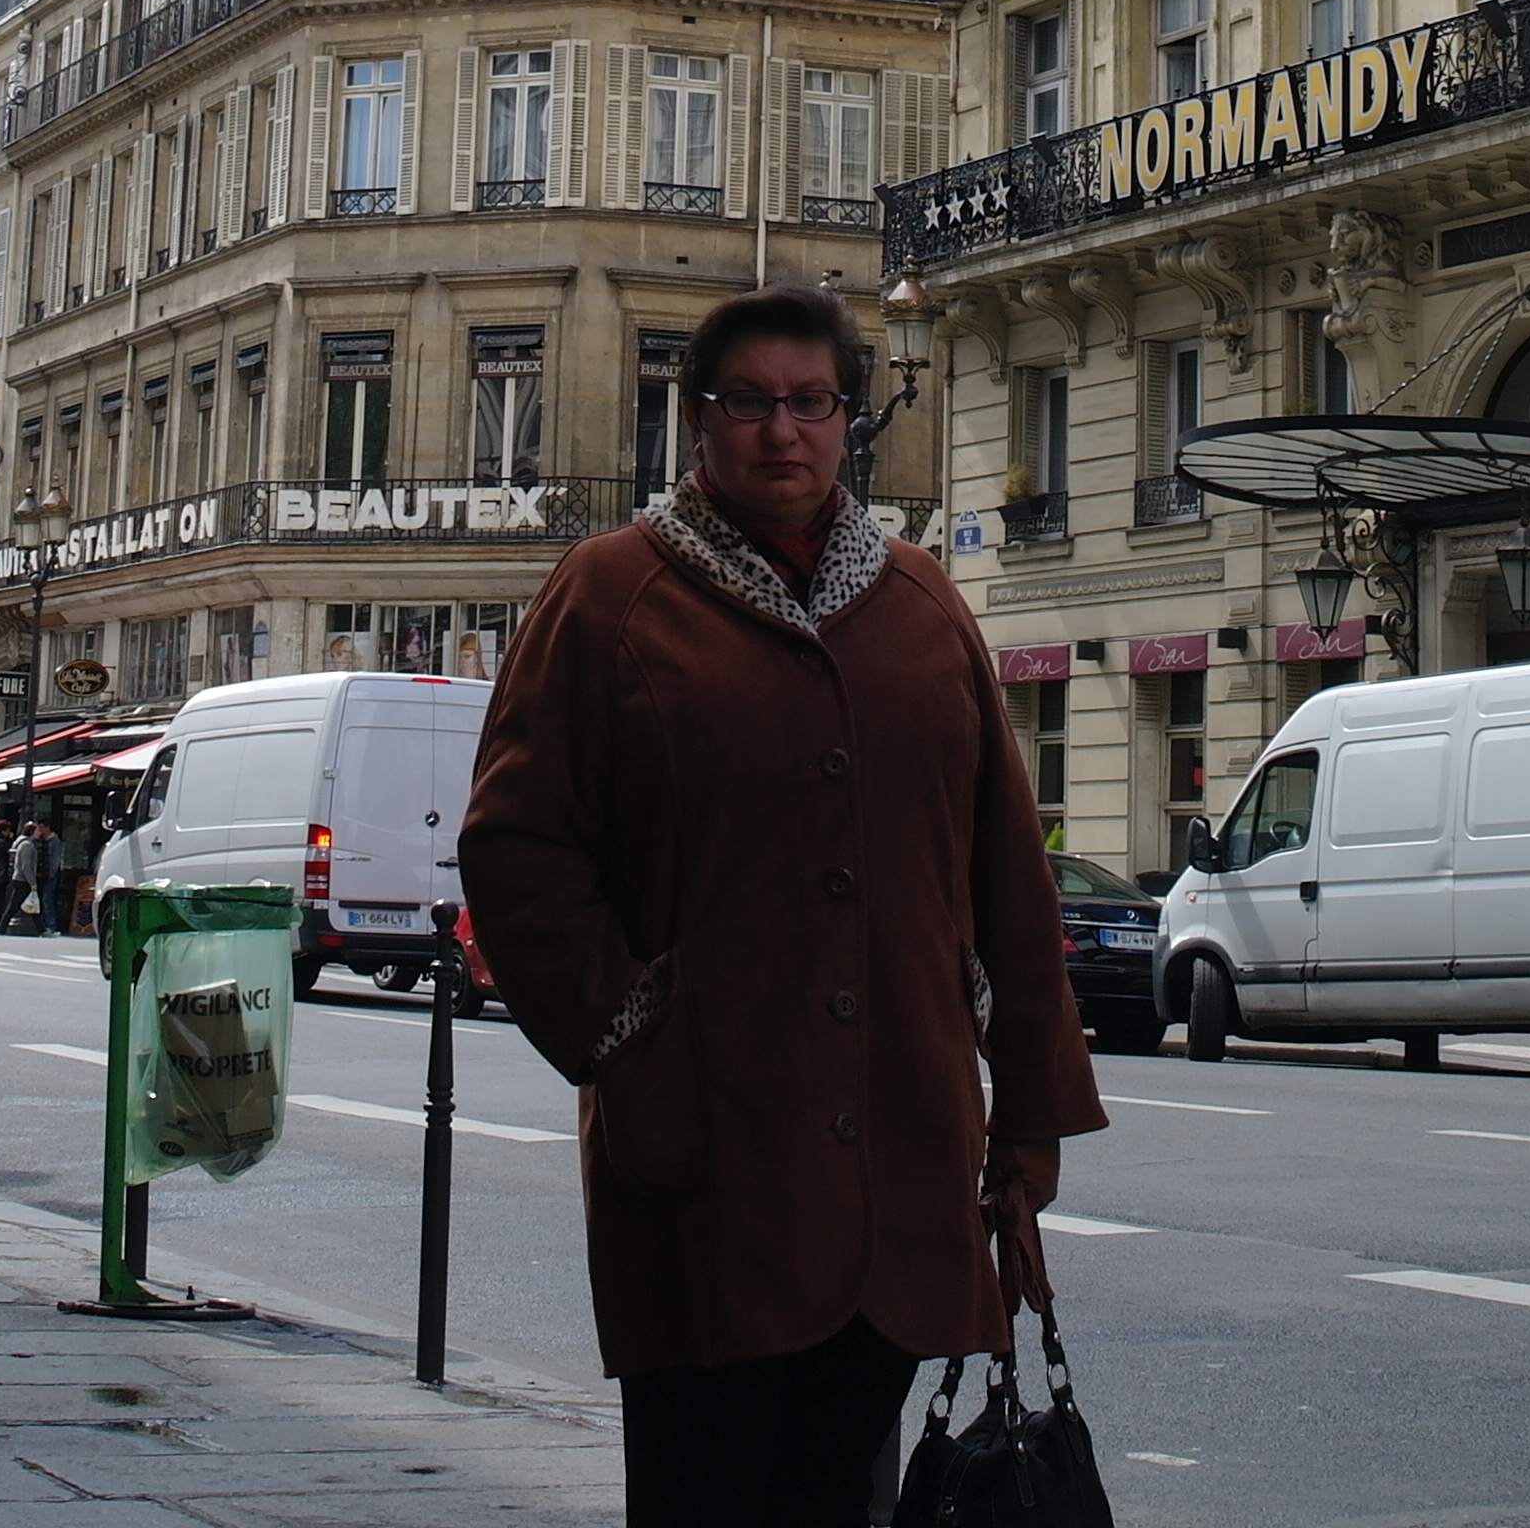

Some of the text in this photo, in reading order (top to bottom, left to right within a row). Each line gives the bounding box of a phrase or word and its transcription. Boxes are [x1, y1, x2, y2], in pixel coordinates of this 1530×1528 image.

[1100, 28, 1430, 203] NORMANDY
[329, 364, 391, 377] BEAUTEX
[478, 360, 542, 374] BEAUTEX
[165, 987, 271, 1016] VIGILANCE
